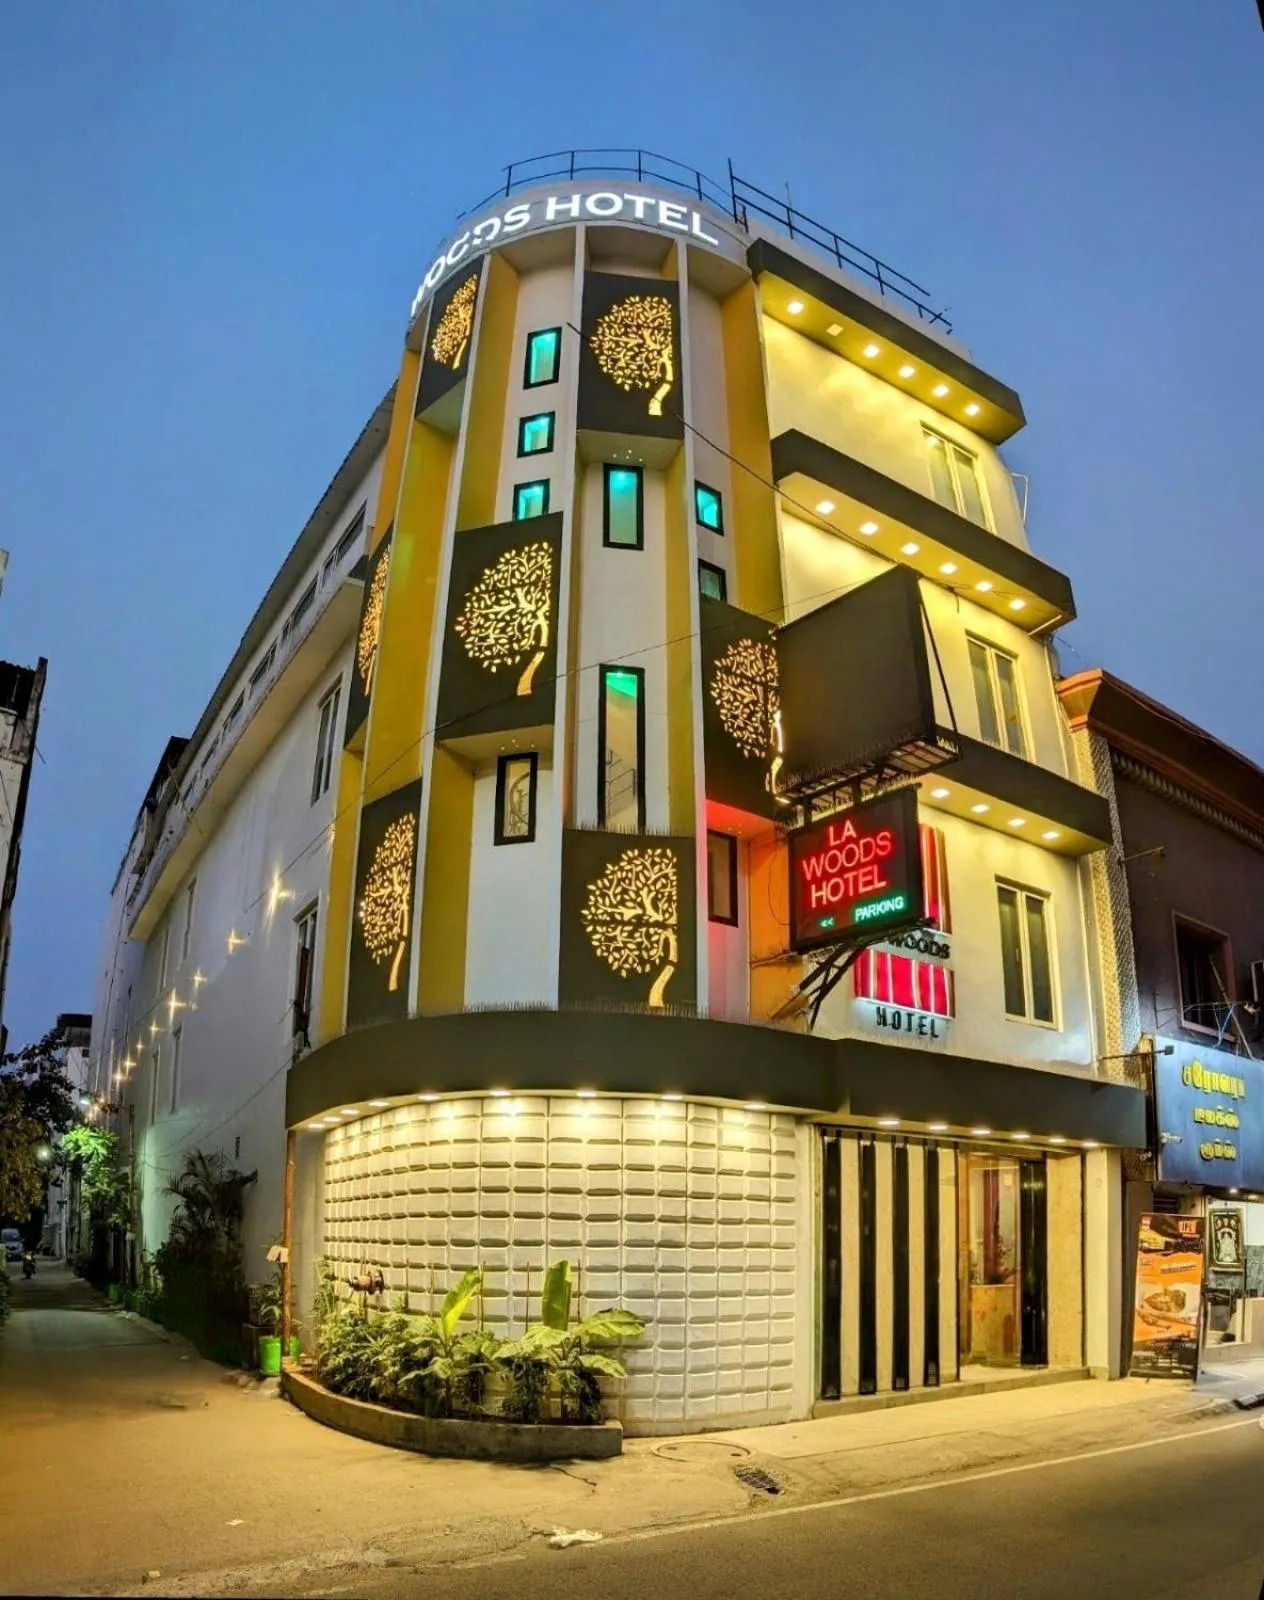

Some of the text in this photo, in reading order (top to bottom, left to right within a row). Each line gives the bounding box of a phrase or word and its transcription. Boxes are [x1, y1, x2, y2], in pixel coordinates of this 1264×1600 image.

[546, 192, 719, 245] HOTEL
[829, 819, 858, 847] LA
[802, 831, 892, 881] WOODS
[811, 864, 887, 908] HOTEL
[855, 896, 905, 922] PARKING
[876, 1006, 939, 1038] HOTEL
